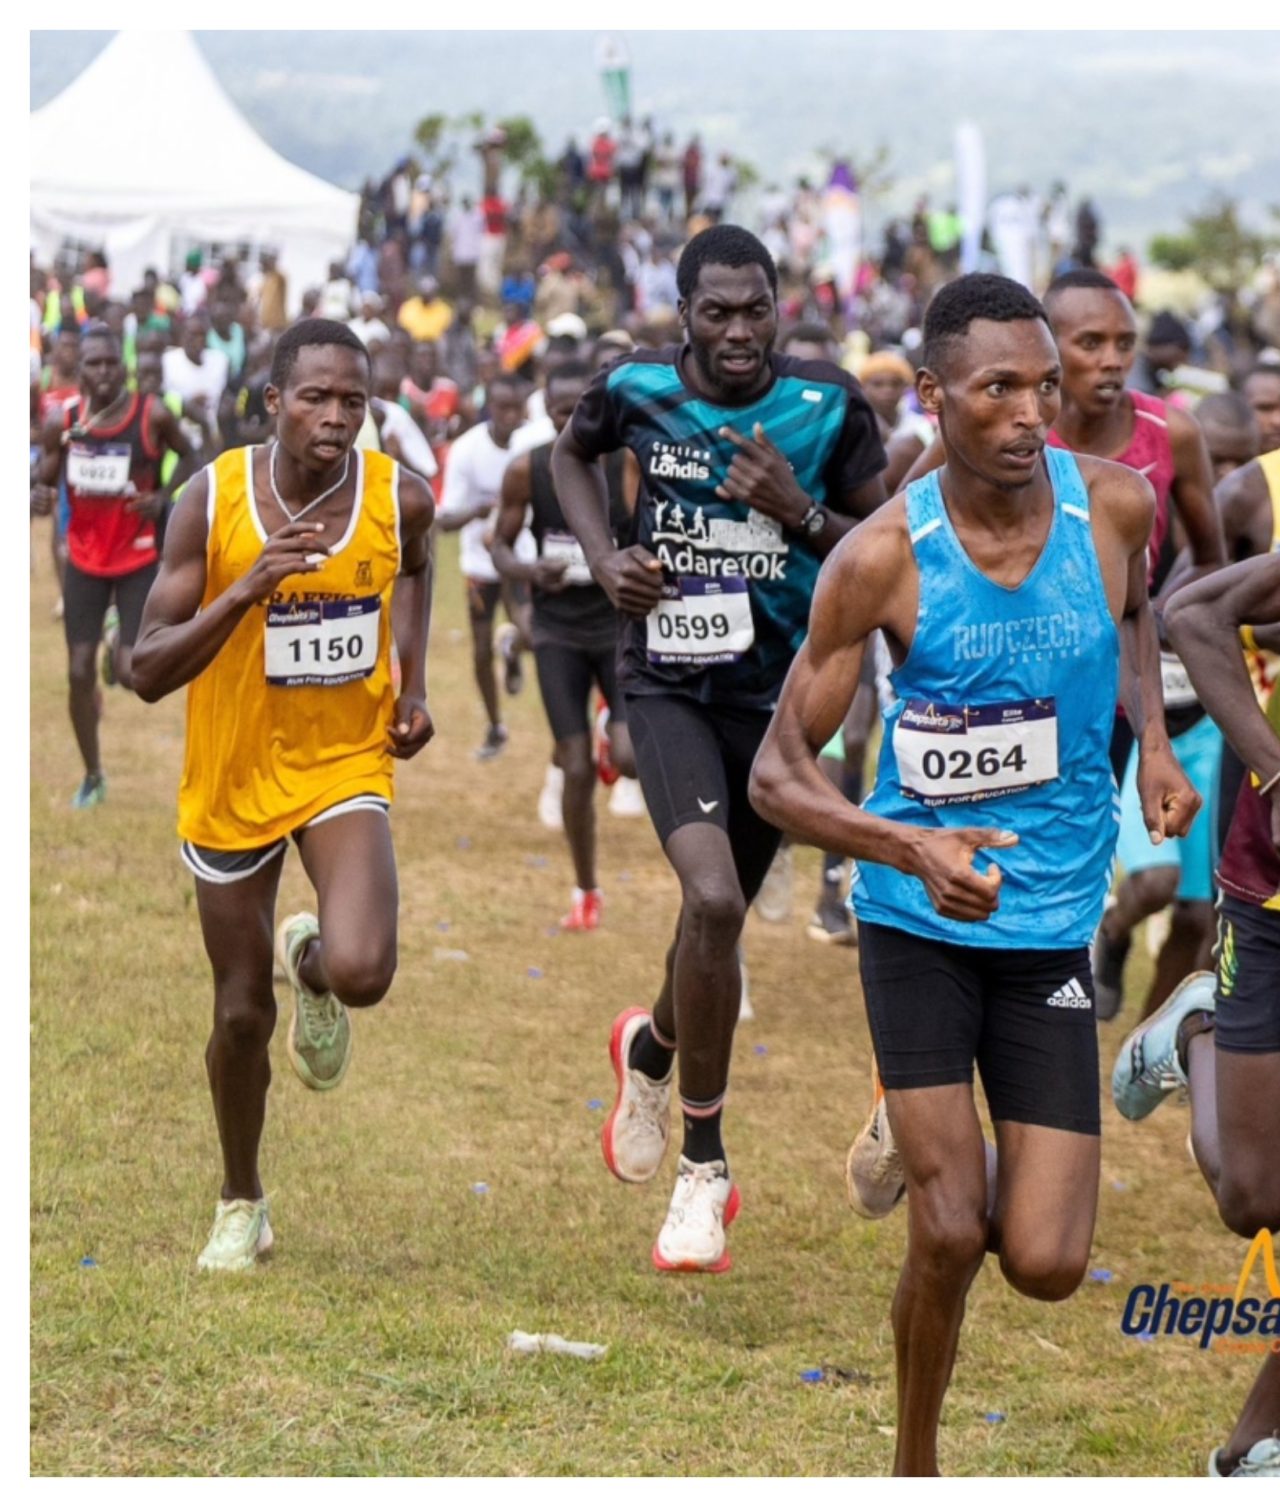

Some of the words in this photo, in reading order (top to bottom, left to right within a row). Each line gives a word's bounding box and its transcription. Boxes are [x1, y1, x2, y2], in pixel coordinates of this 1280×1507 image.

[650, 455, 710, 480] Londis
[657, 612, 730, 640] 0599
[288, 634, 364, 663] 1150
[1003, 708, 1024, 718] Elite
[921, 743, 1028, 781] 0264
[922, 796, 946, 808] RUN
[947, 793, 971, 805] FOR
[971, 784, 1031, 802] EDUCATION
[1046, 997, 1092, 1009] adidas
